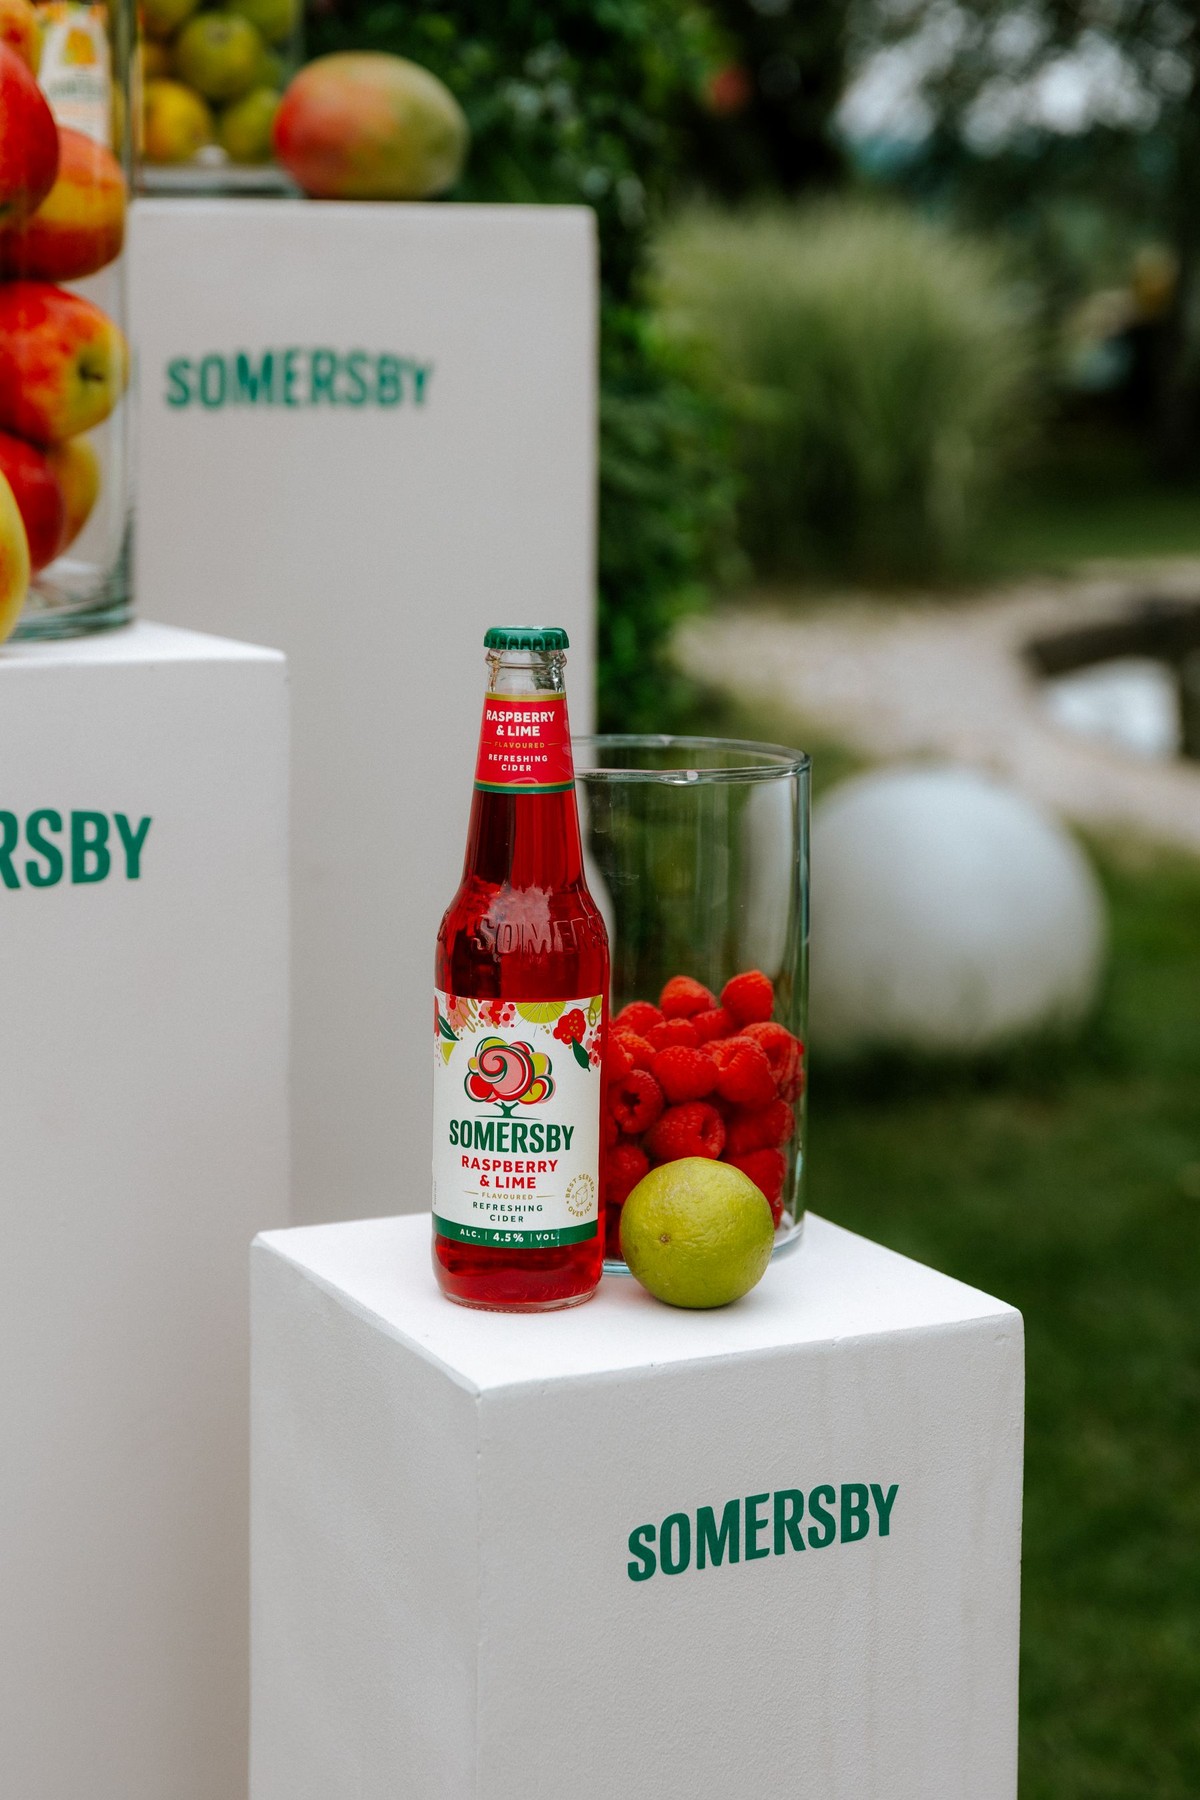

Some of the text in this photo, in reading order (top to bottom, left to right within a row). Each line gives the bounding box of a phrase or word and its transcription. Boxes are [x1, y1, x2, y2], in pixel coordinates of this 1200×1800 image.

[166, 347, 434, 409] SOMERSBY
[486, 709, 555, 723] RASPBERRY
[496, 725, 541, 737] & LIME
[494, 741, 545, 749] FLAVOURED
[488, 753, 548, 762] REFRESHING
[501, 764, 532, 772] CIDER
[449, 1119, 575, 1154] SOMERSBY
[461, 1155, 558, 1173] RASPBERRY
[479, 1174, 537, 1189] & LIME
[564, 1173, 595, 1199] BEST SERVED
[481, 1191, 534, 1200] FLAVOURED
[472, 1201, 544, 1212] REFRESHING
[567, 1201, 593, 1218] OVER ICE
[489, 1214, 525, 1223] CIDER
[459, 1228, 560, 1243] ALC. 4.5% VOL.
[626, 1483, 900, 1582] SOMERSBY
